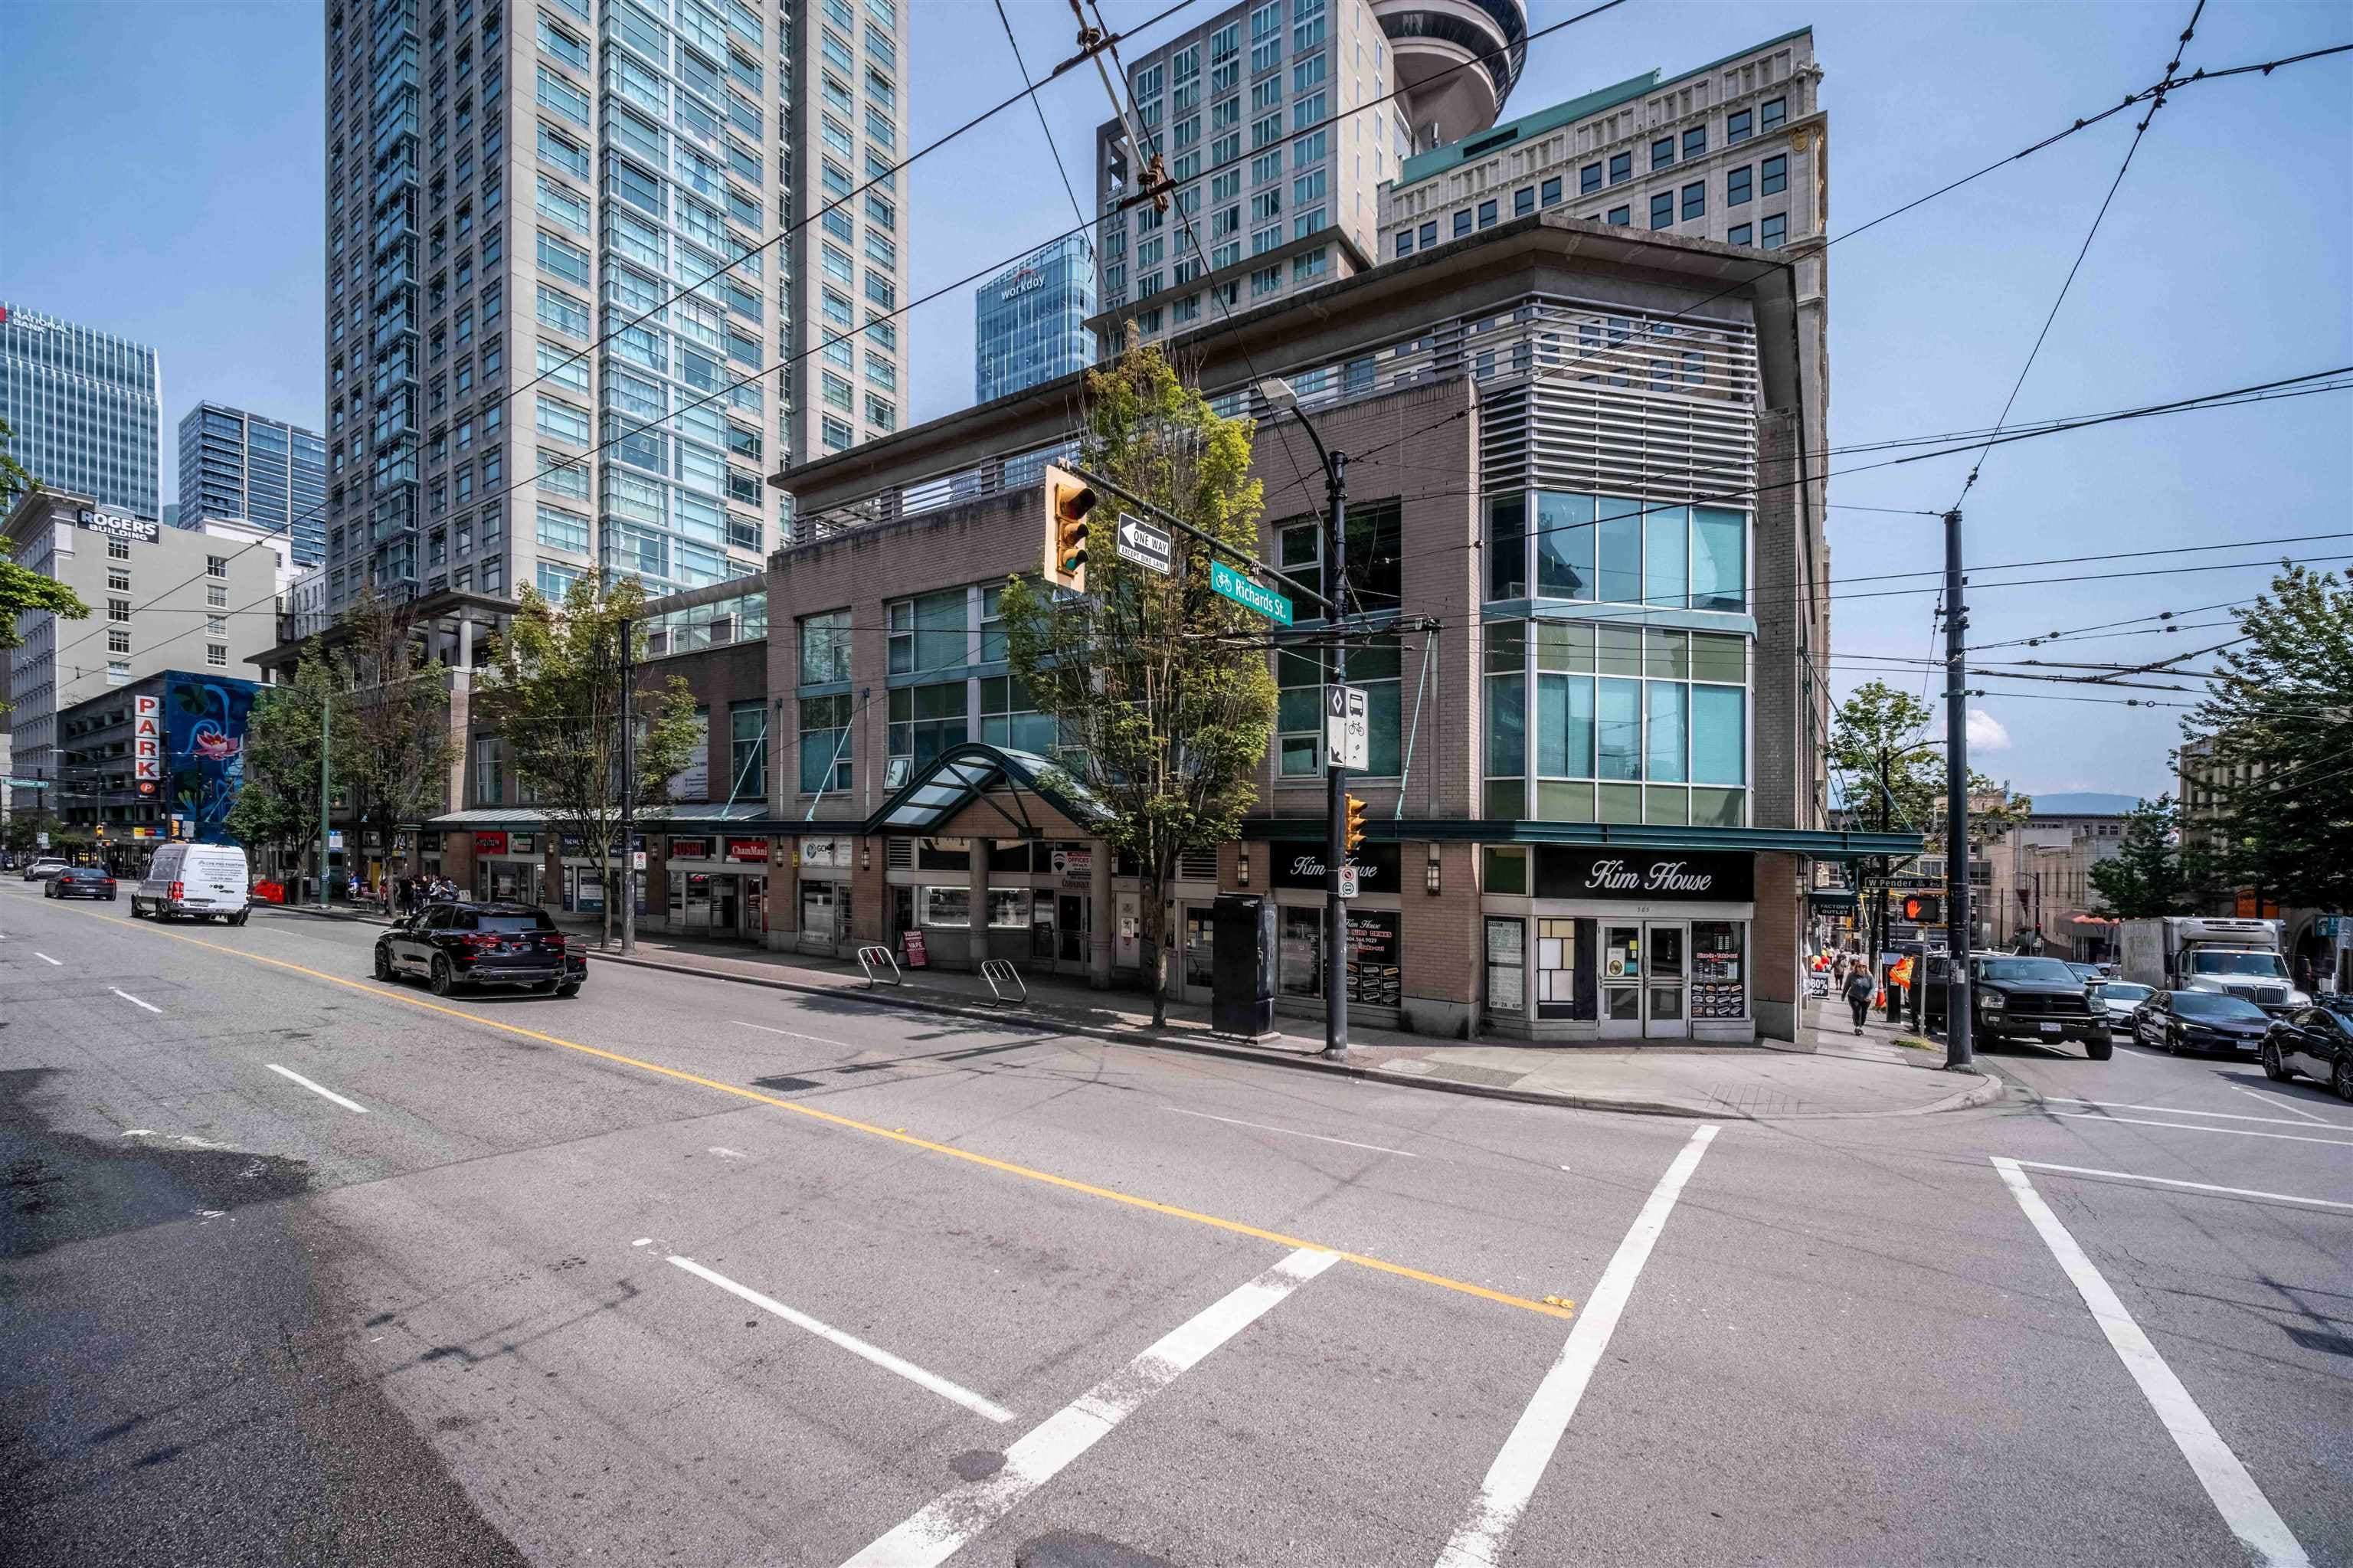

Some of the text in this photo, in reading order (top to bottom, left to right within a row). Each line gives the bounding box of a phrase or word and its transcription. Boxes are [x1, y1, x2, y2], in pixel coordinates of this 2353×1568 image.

[1002, 275, 1045, 300] workday
[13, 311, 70, 334] NATIONAL
[13, 319, 46, 334] BANK
[81, 510, 156, 535] ROGERS
[89, 524, 148, 540] BUILDING
[1134, 530, 1167, 554] ONE WAY
[1121, 546, 1166, 570] EXCEPT BIKE LANE
[1235, 578, 1287, 619] Richards St.
[139, 698, 157, 777] PARK
[1290, 856, 1327, 876] Kim
[1585, 859, 1712, 891] Kim House
[1880, 879, 1912, 888] Pender
[1360, 919, 1381, 929] House
